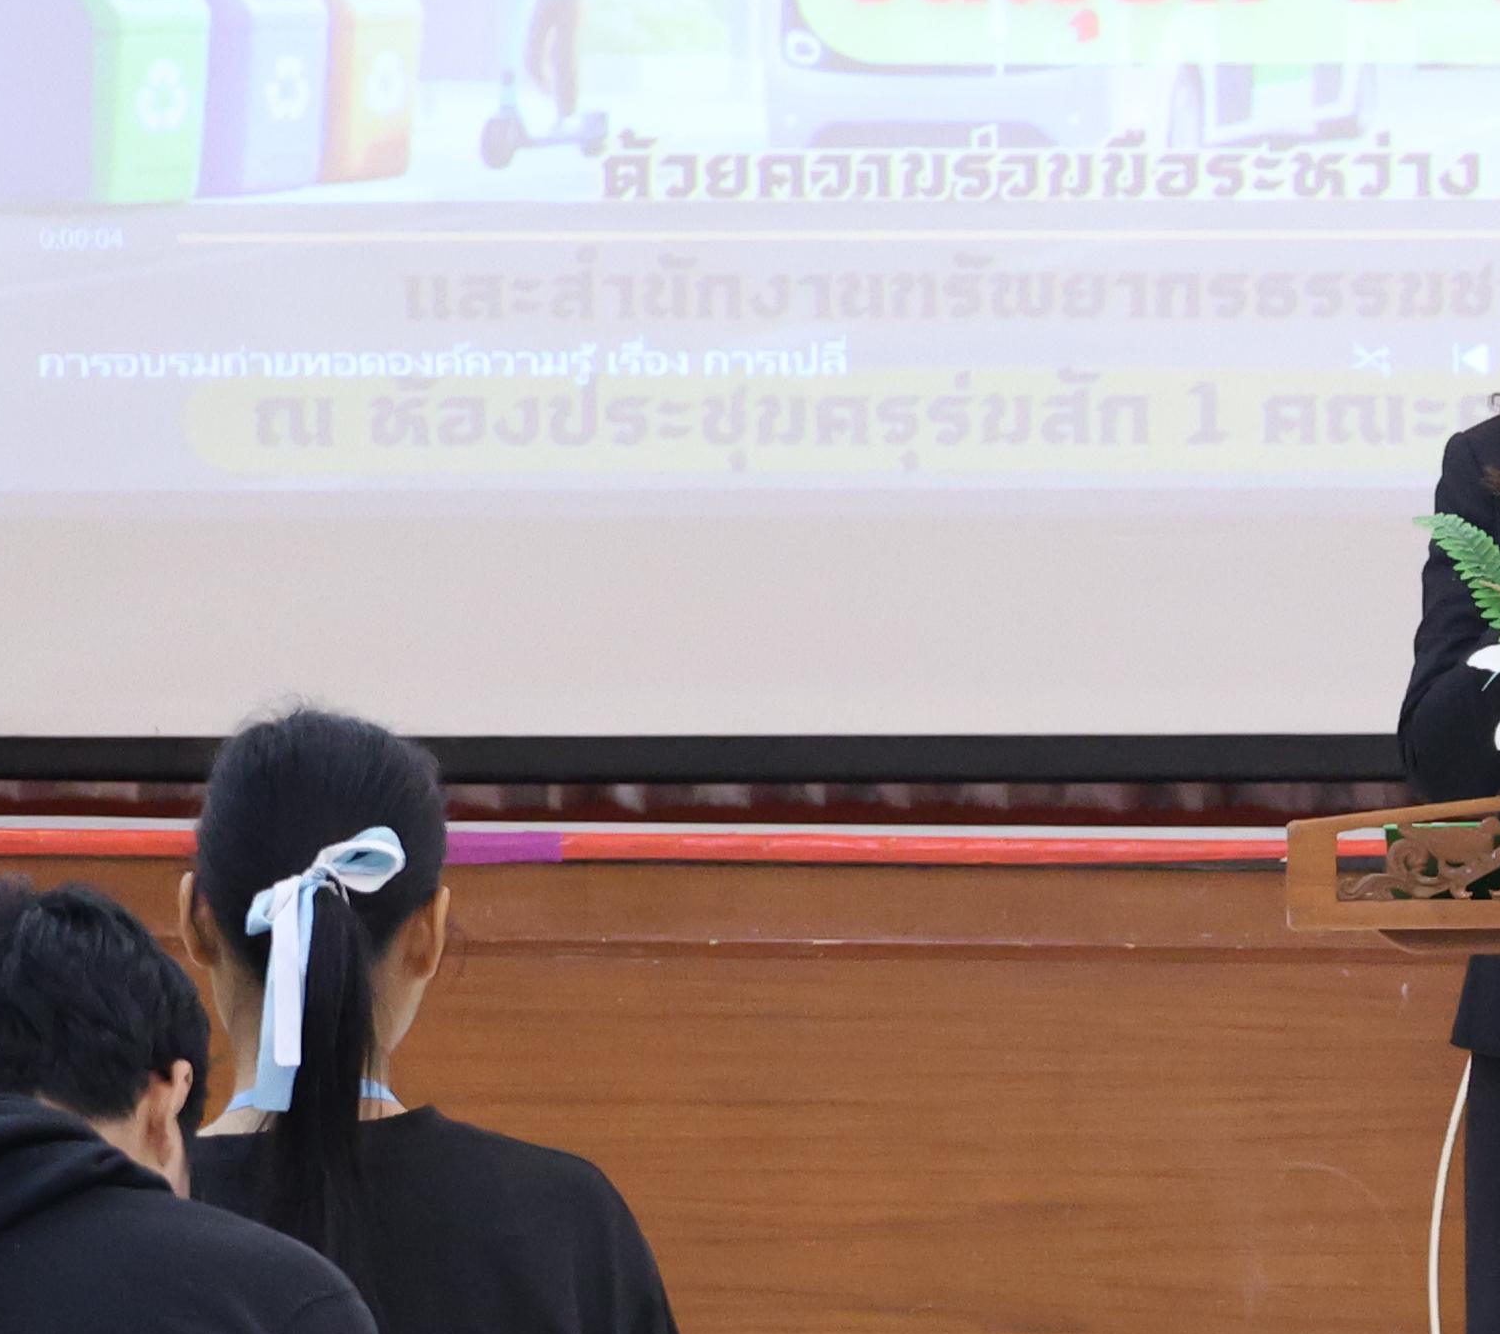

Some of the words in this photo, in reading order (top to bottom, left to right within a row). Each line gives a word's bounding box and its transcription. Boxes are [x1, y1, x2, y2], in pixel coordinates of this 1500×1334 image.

[601, 126, 1482, 201] ด้วยความร่วมมือระหว่าง
[607, 334, 689, 377] เรื่อง
[252, 384, 339, 449] ณ
[1184, 379, 1231, 445] 1
